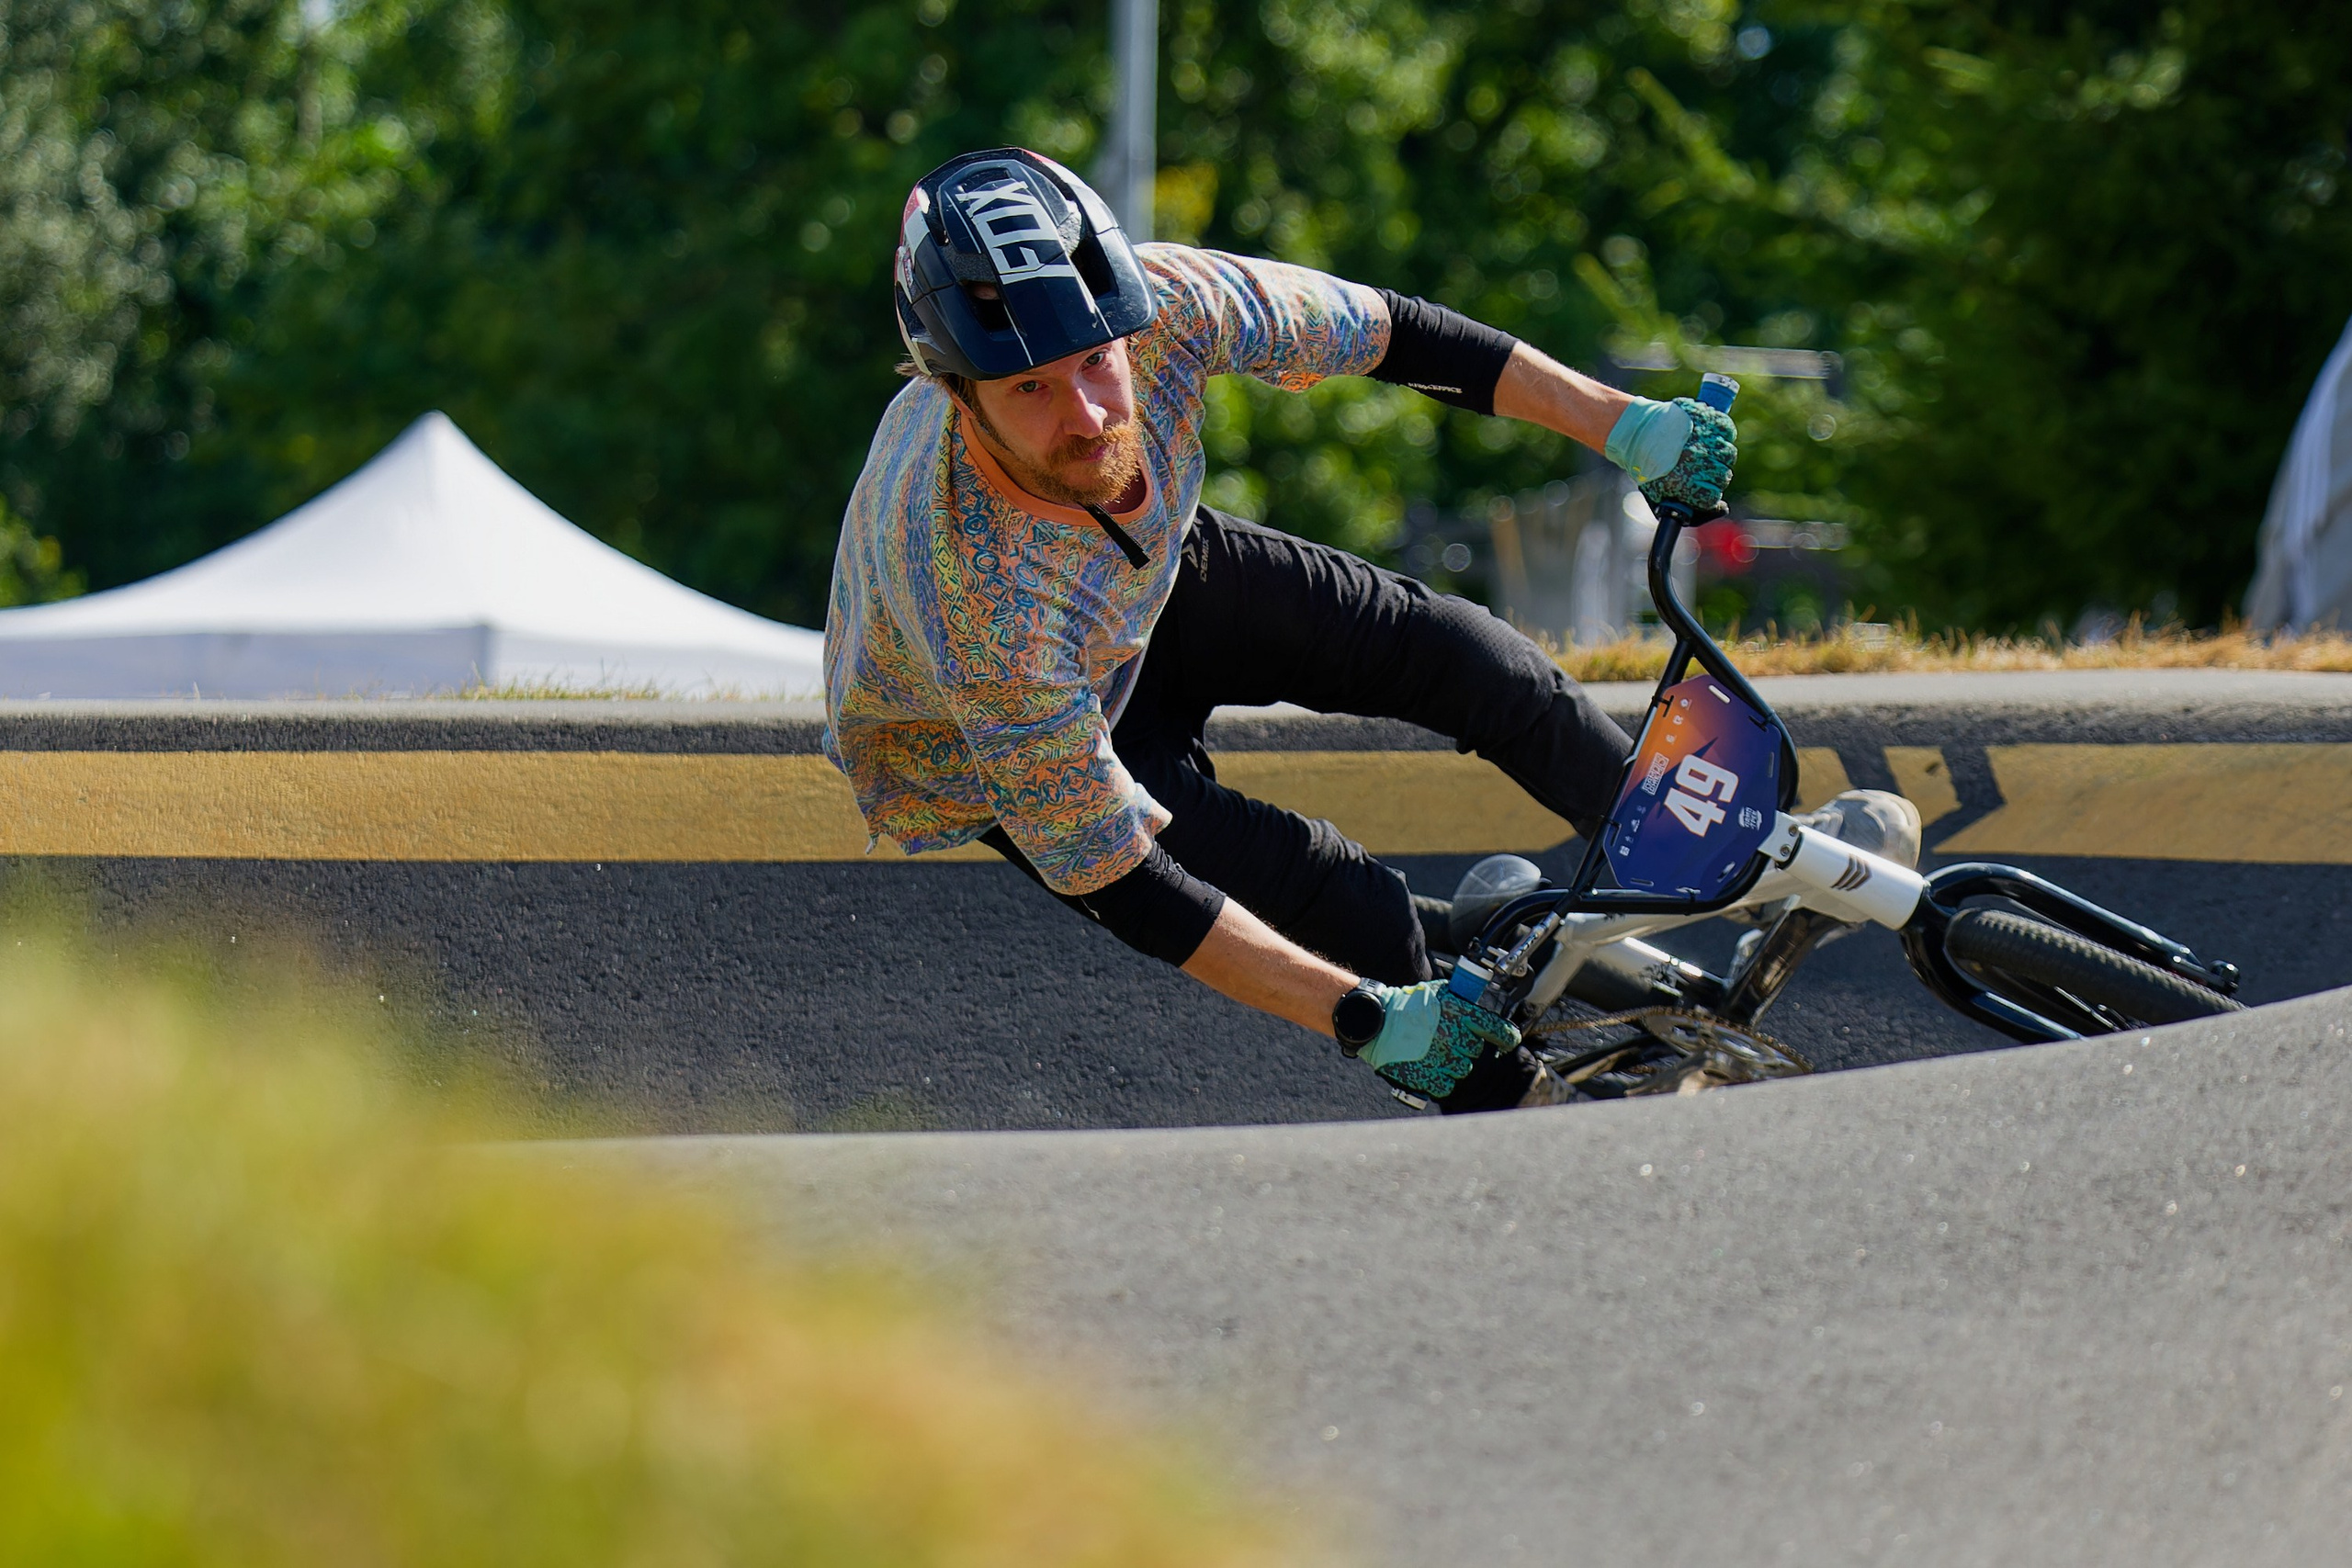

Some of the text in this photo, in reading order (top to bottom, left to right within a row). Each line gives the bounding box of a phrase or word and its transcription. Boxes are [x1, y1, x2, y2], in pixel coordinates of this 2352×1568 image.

[956, 181, 1076, 285] FOX
[1200, 536, 1209, 582] DEMIX
[1664, 753, 1739, 837] 49
